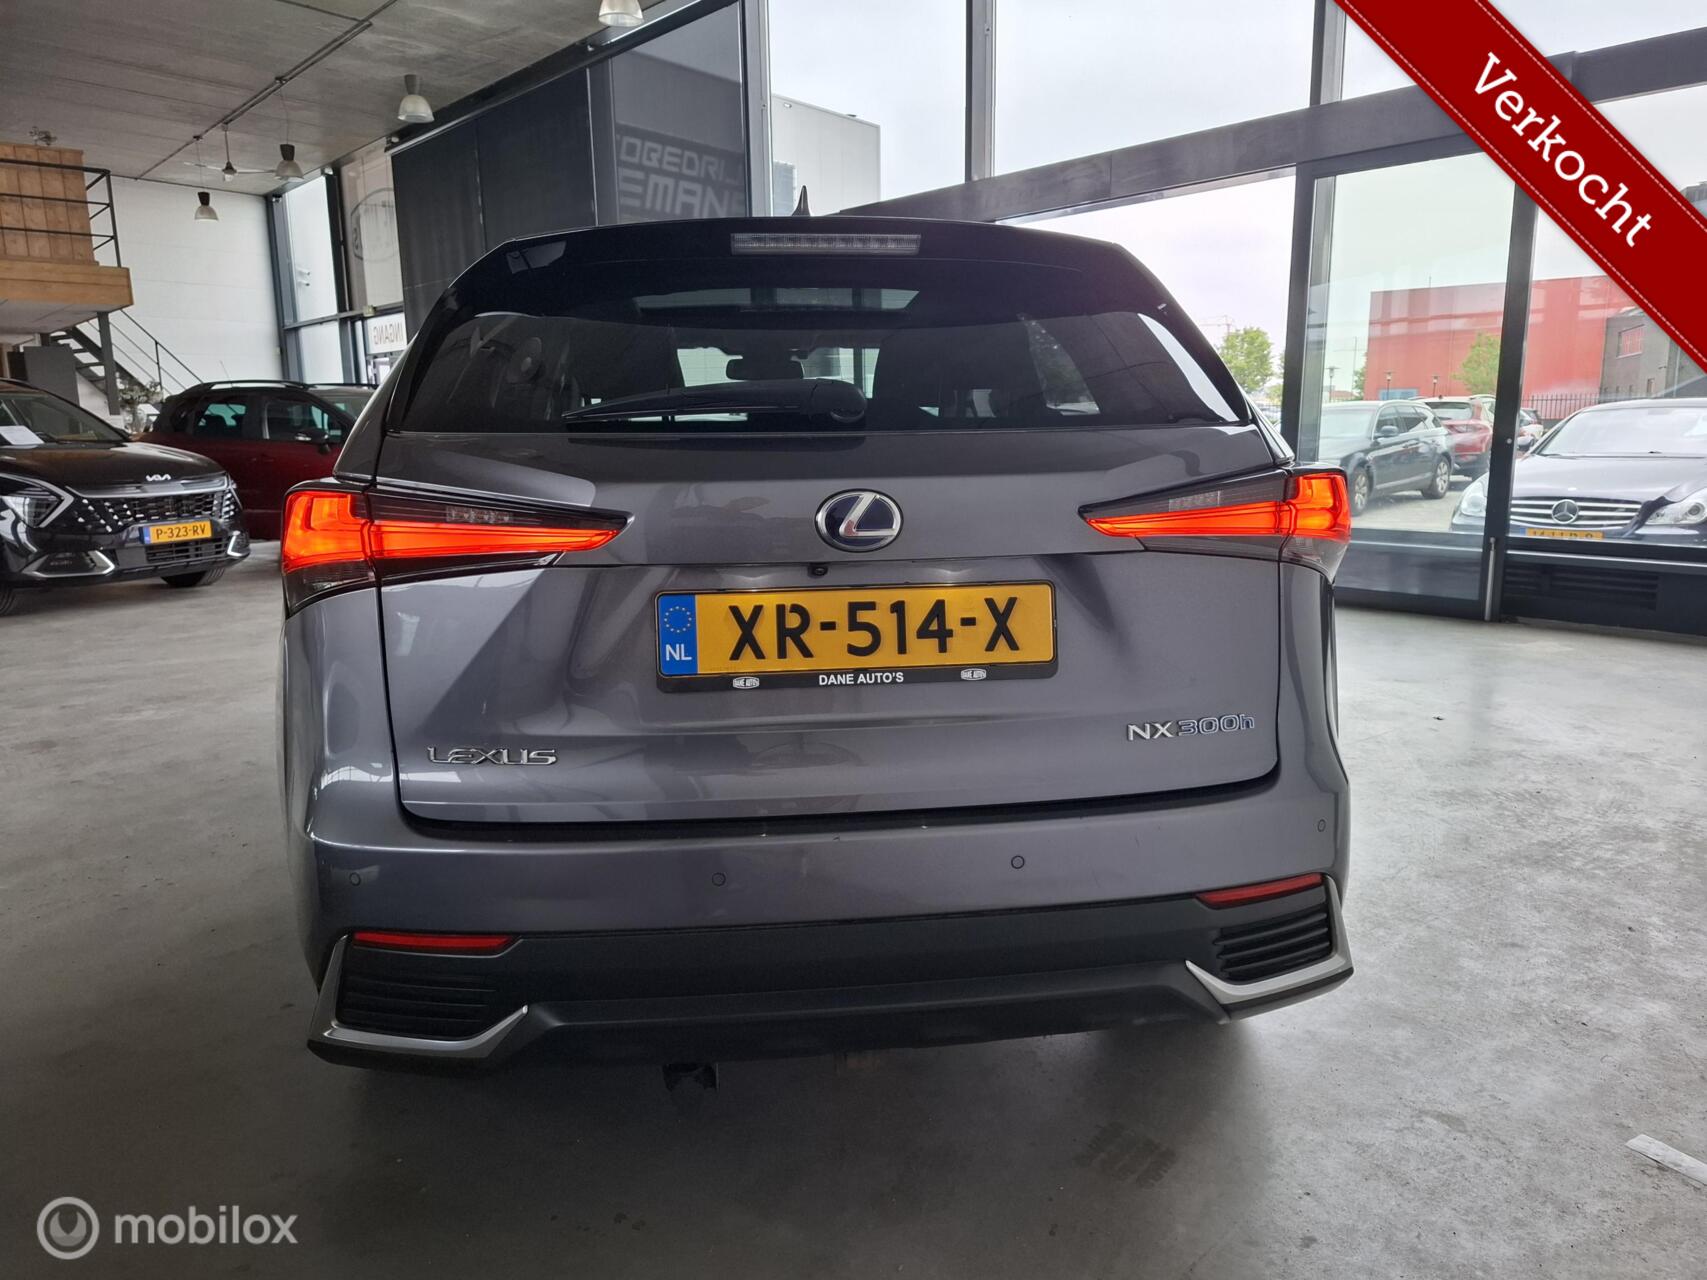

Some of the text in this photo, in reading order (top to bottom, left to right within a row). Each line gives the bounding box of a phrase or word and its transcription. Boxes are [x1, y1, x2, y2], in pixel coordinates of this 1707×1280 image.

[155, 524, 206, 540] P-323-RV
[727, 596, 1021, 661] XR-514-X
[665, 644, 692, 661] NL
[818, 672, 904, 686] DANE AUTO'S
[427, 746, 557, 765] LEXUS
